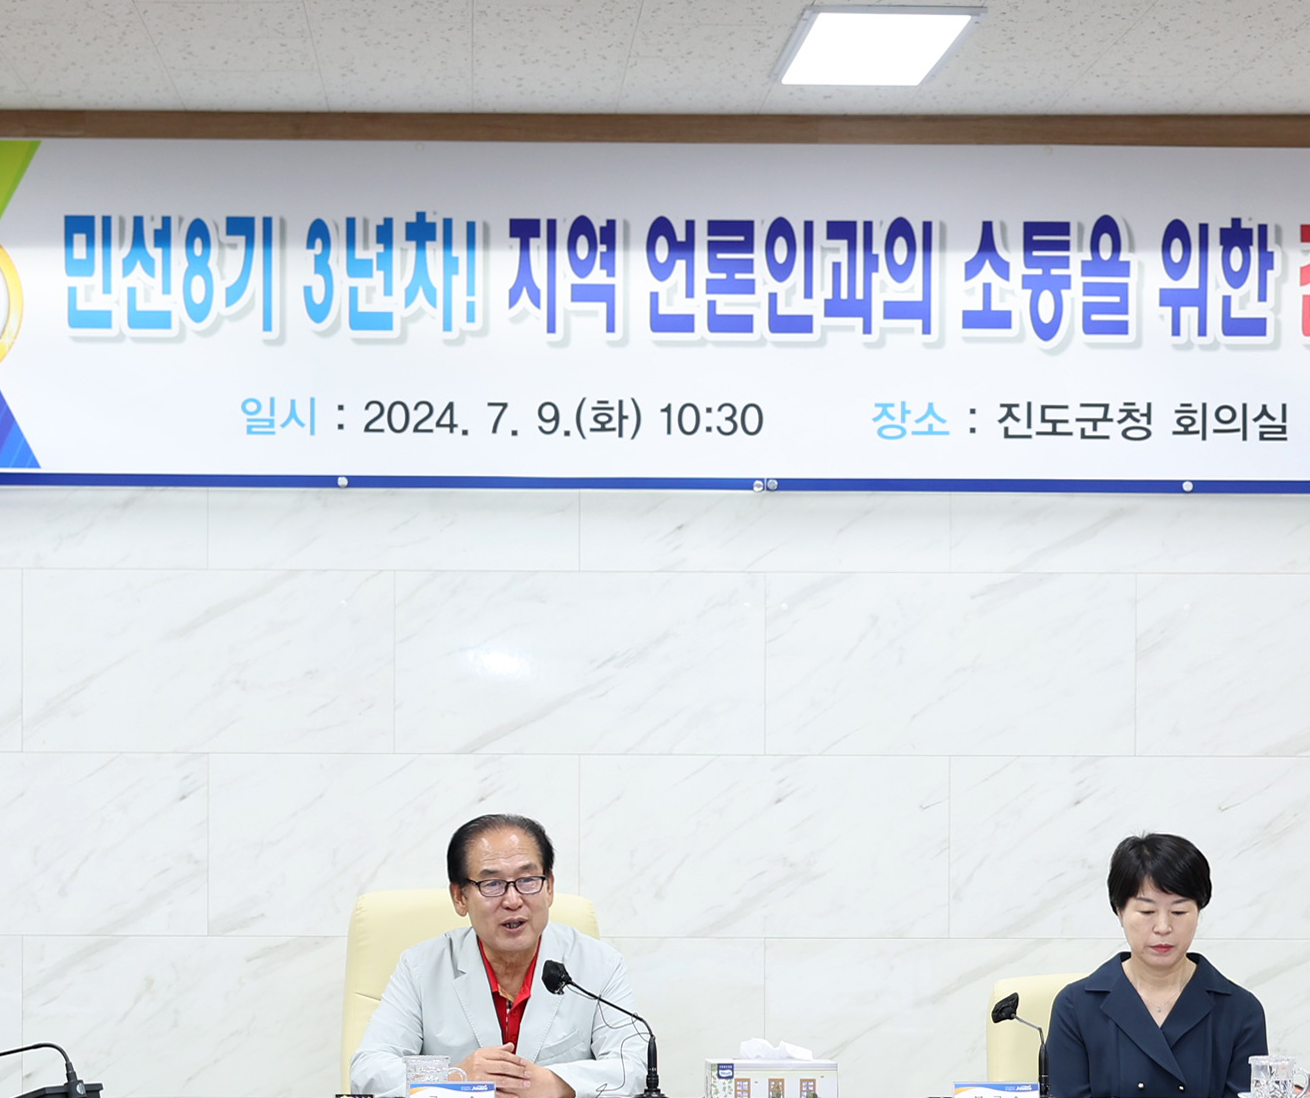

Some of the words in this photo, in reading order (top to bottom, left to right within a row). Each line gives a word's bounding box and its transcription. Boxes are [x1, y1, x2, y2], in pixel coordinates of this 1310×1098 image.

[64, 213, 275, 332] 민선8기
[303, 212, 478, 333] 3년차!
[507, 214, 617, 334] 지역
[645, 215, 933, 336] 언론인과의
[961, 214, 1131, 342] 소통을
[1158, 217, 1275, 338] 위한
[240, 396, 316, 437] 일시
[363, 399, 470, 437] 2024.
[486, 401, 520, 437] 7.
[537, 396, 642, 441] 9.(화)
[659, 402, 764, 437] 10:30
[872, 400, 950, 441] 장소
[997, 400, 1153, 442] 진도군청
[1171, 401, 1289, 442] 회의실
